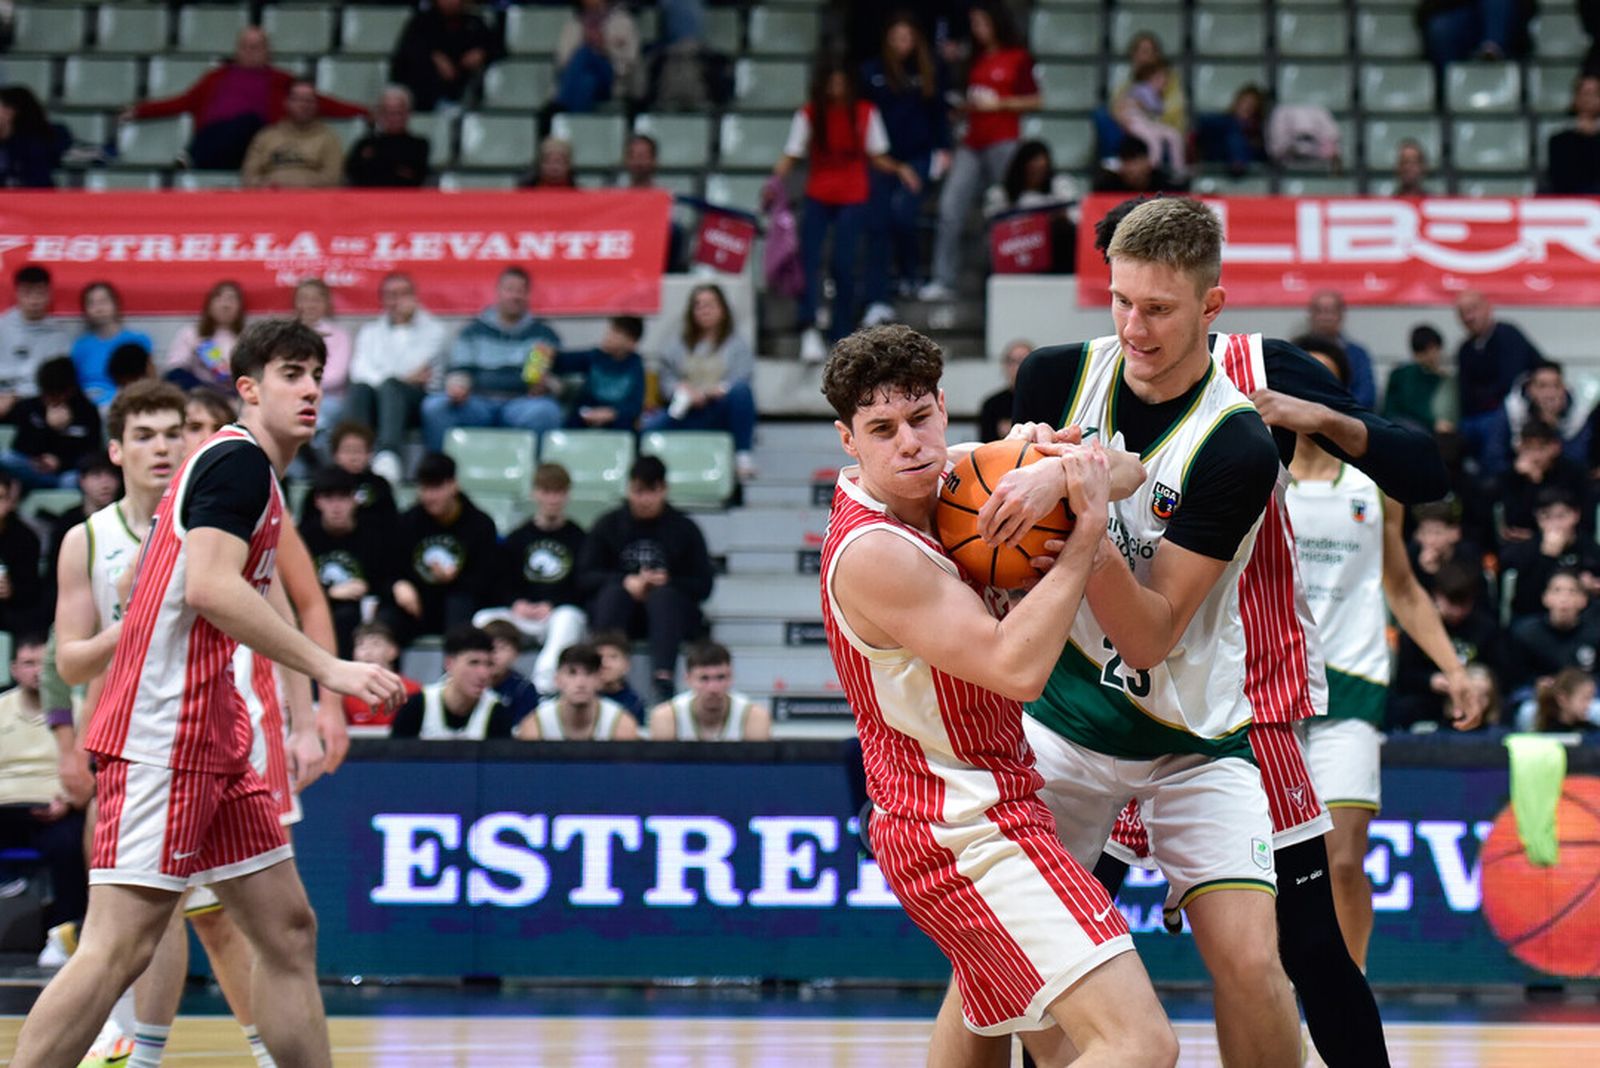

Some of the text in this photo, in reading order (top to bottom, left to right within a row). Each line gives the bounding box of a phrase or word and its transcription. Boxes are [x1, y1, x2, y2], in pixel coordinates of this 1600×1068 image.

[28, 232, 321, 262] ESTRELLA
[372, 230, 634, 261] LEVANTE
[1156, 484, 1177, 501] LIGA
[370, 811, 902, 907] ESTRE
